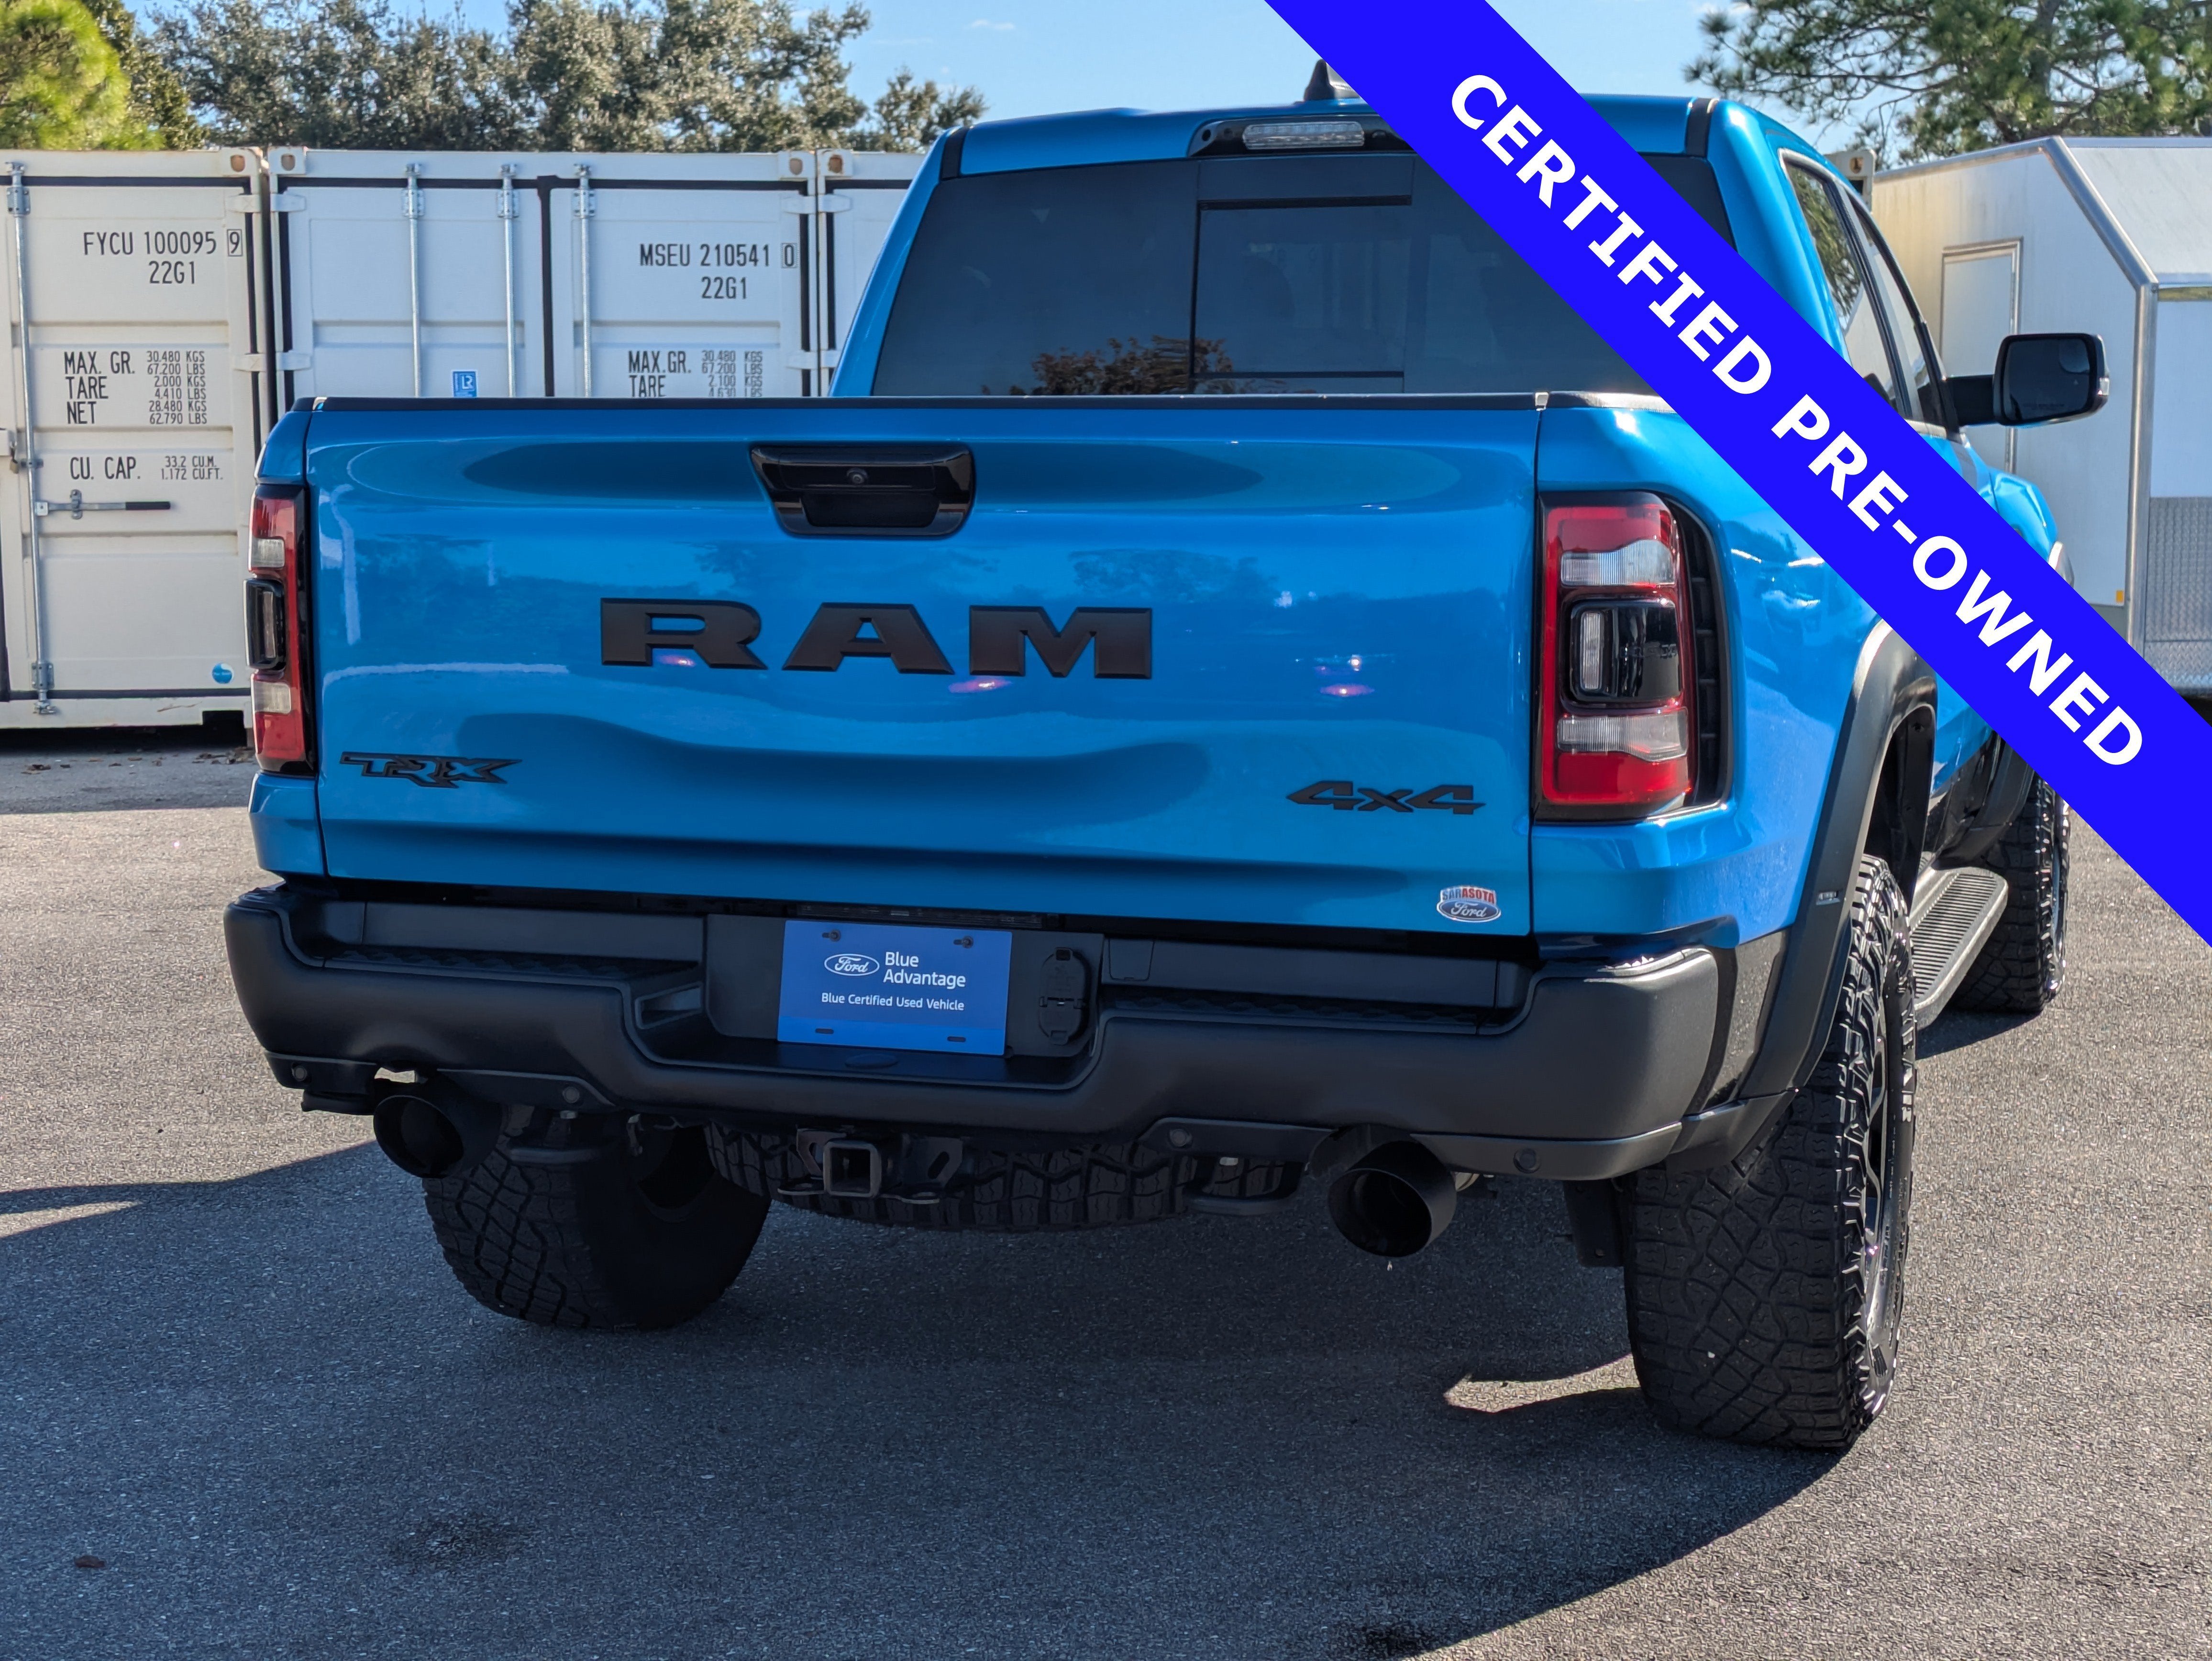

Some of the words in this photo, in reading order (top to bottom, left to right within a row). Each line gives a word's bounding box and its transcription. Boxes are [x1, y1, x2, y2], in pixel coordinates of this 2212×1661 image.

[83, 232, 133, 255] FYCU
[144, 232, 217, 254] 100095
[229, 231, 241, 255] 9
[640, 244, 690, 266] MSEU
[700, 244, 769, 266] 210541
[149, 261, 195, 284] 22G1
[701, 276, 746, 299] 22G1
[64, 351, 102, 374] MAX.
[111, 351, 135, 374] GR.
[146, 351, 180, 362] 30.480
[186, 351, 205, 362] KGS
[744, 351, 763, 362] KGS
[147, 363, 180, 375] 67.200
[187, 363, 205, 375] LBS
[745, 363, 763, 375] LBS
[66, 376, 109, 399] TARE
[154, 376, 181, 388] 2.000
[187, 376, 206, 388] KGS
[629, 375, 667, 398] TARE
[745, 375, 763, 387] KGS
[155, 388, 182, 399] 4.410
[188, 388, 206, 399] LBS
[66, 401, 97, 424] NET
[149, 400, 182, 412] 28.480
[188, 400, 207, 412] KGS
[150, 413, 183, 424] 62.790
[189, 413, 207, 424] LBS
[70, 457, 94, 480] CU.
[105, 457, 141, 480] CAP.
[165, 456, 186, 467] 33.2
[161, 468, 187, 480] 1.172
[600, 597, 1152, 679] RAM
[339, 751, 522, 788] TRX
[1443, 888, 1495, 904] SARASOTA
[1450, 901, 1487, 918] Ford
[832, 955, 871, 974] Ford
[885, 952, 918, 967] Blue
[883, 969, 965, 990] Advantage
[821, 993, 845, 1003] Blue
[848, 994, 892, 1006] Certified
[896, 997, 923, 1008] Used
[927, 999, 964, 1011] Vehicle
